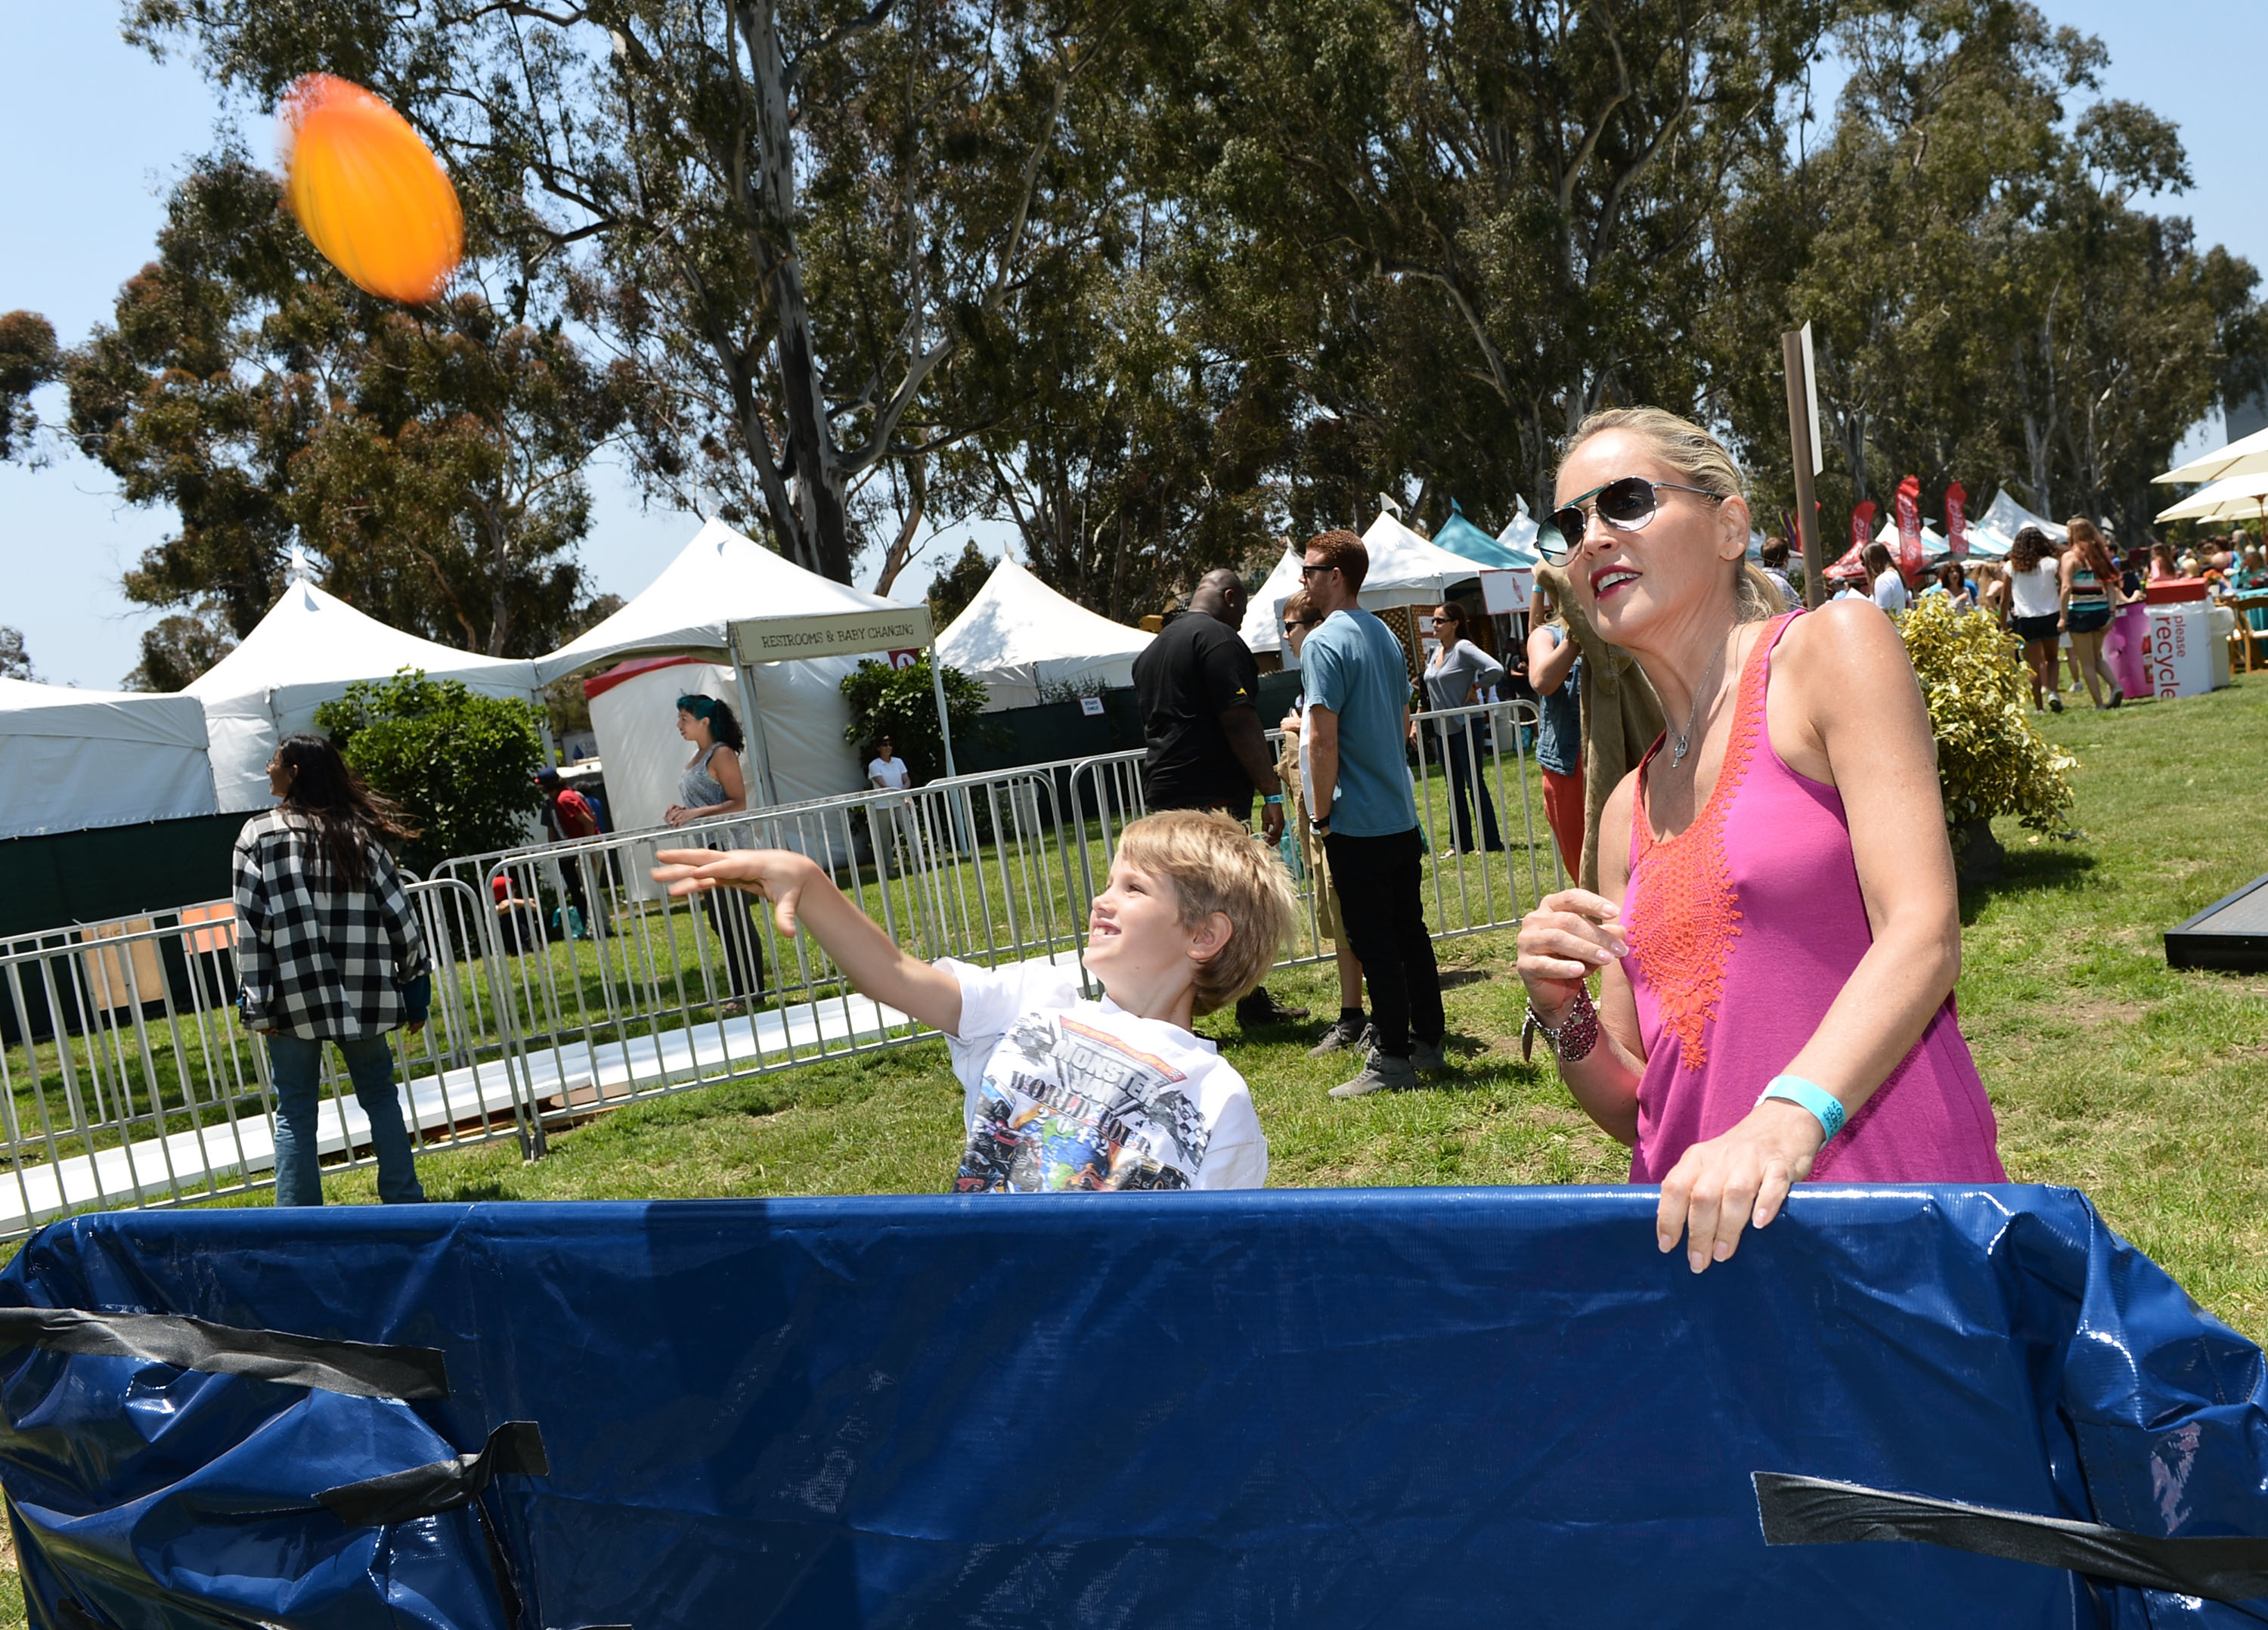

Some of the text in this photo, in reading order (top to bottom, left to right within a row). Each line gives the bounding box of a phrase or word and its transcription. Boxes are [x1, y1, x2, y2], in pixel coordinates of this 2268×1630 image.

[761, 624, 914, 649] RESTROOMS & BABY CHANGING
[2154, 617, 2180, 698] recycle
[2173, 615, 2186, 658] please
[1050, 1039, 1160, 1108] MONSTER
[1070, 1068, 1126, 1110] JAM
[1011, 1070, 1151, 1155] WORLD TOUR
[1033, 1107, 1110, 1157] 2012
